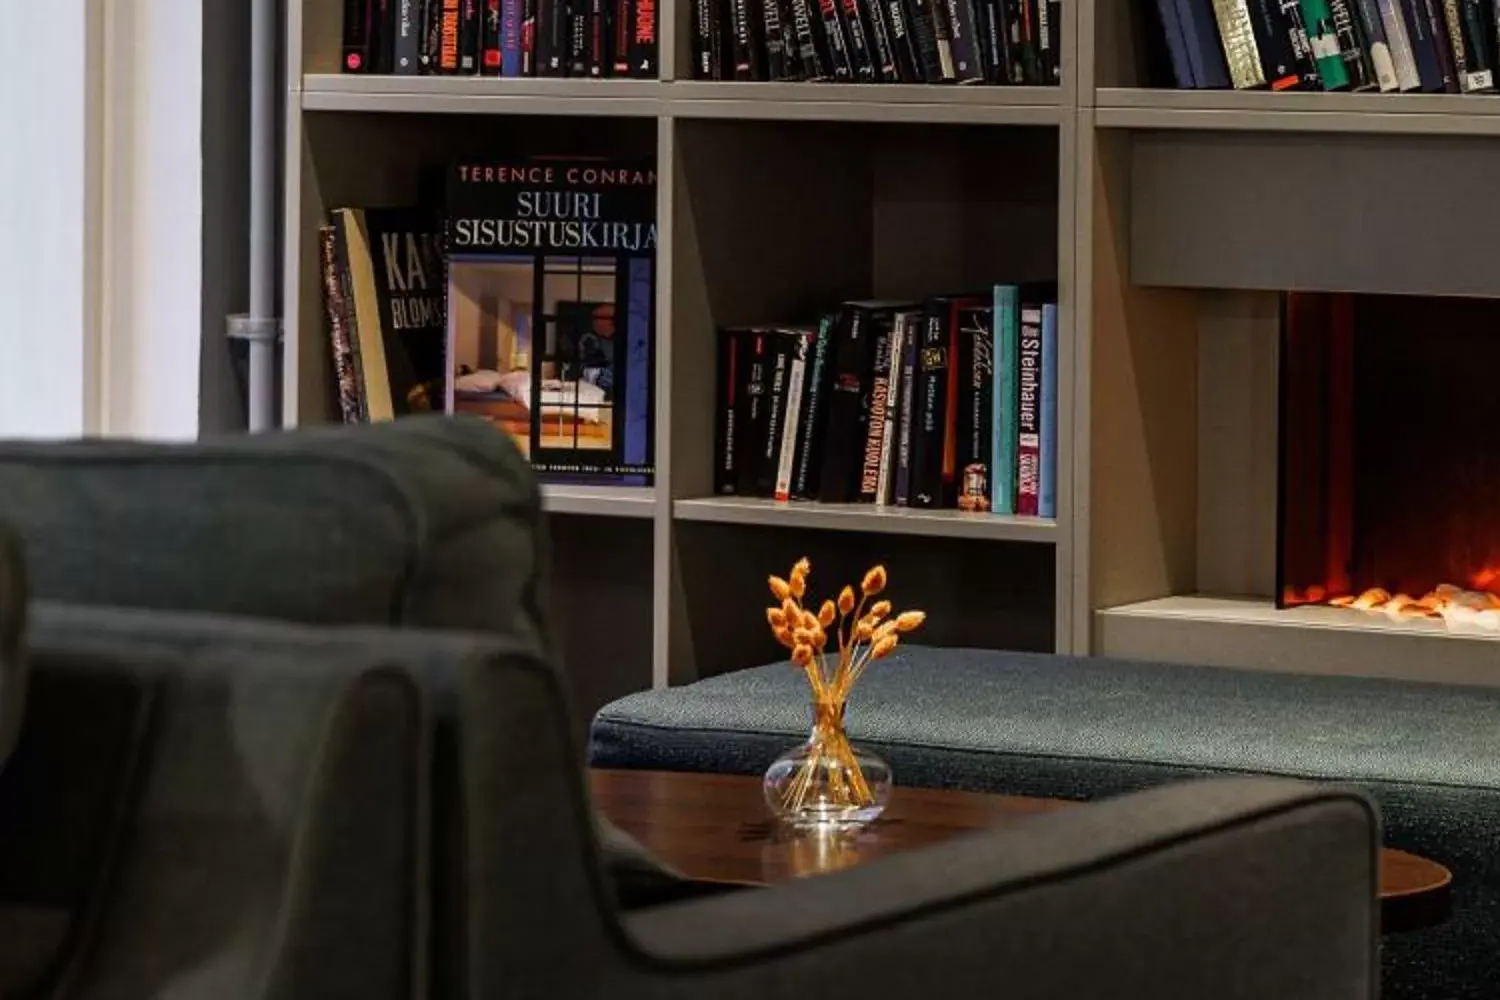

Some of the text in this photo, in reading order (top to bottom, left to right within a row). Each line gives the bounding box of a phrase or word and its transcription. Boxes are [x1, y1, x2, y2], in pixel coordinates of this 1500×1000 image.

[456, 165, 555, 184] TERENCE
[517, 191, 602, 219] SUURI
[455, 218, 657, 252] SISUSTUSKIRJA
[1020, 338, 1039, 430] Steinhauer
[860, 376, 888, 494] KASVOTON KUOLEMA
